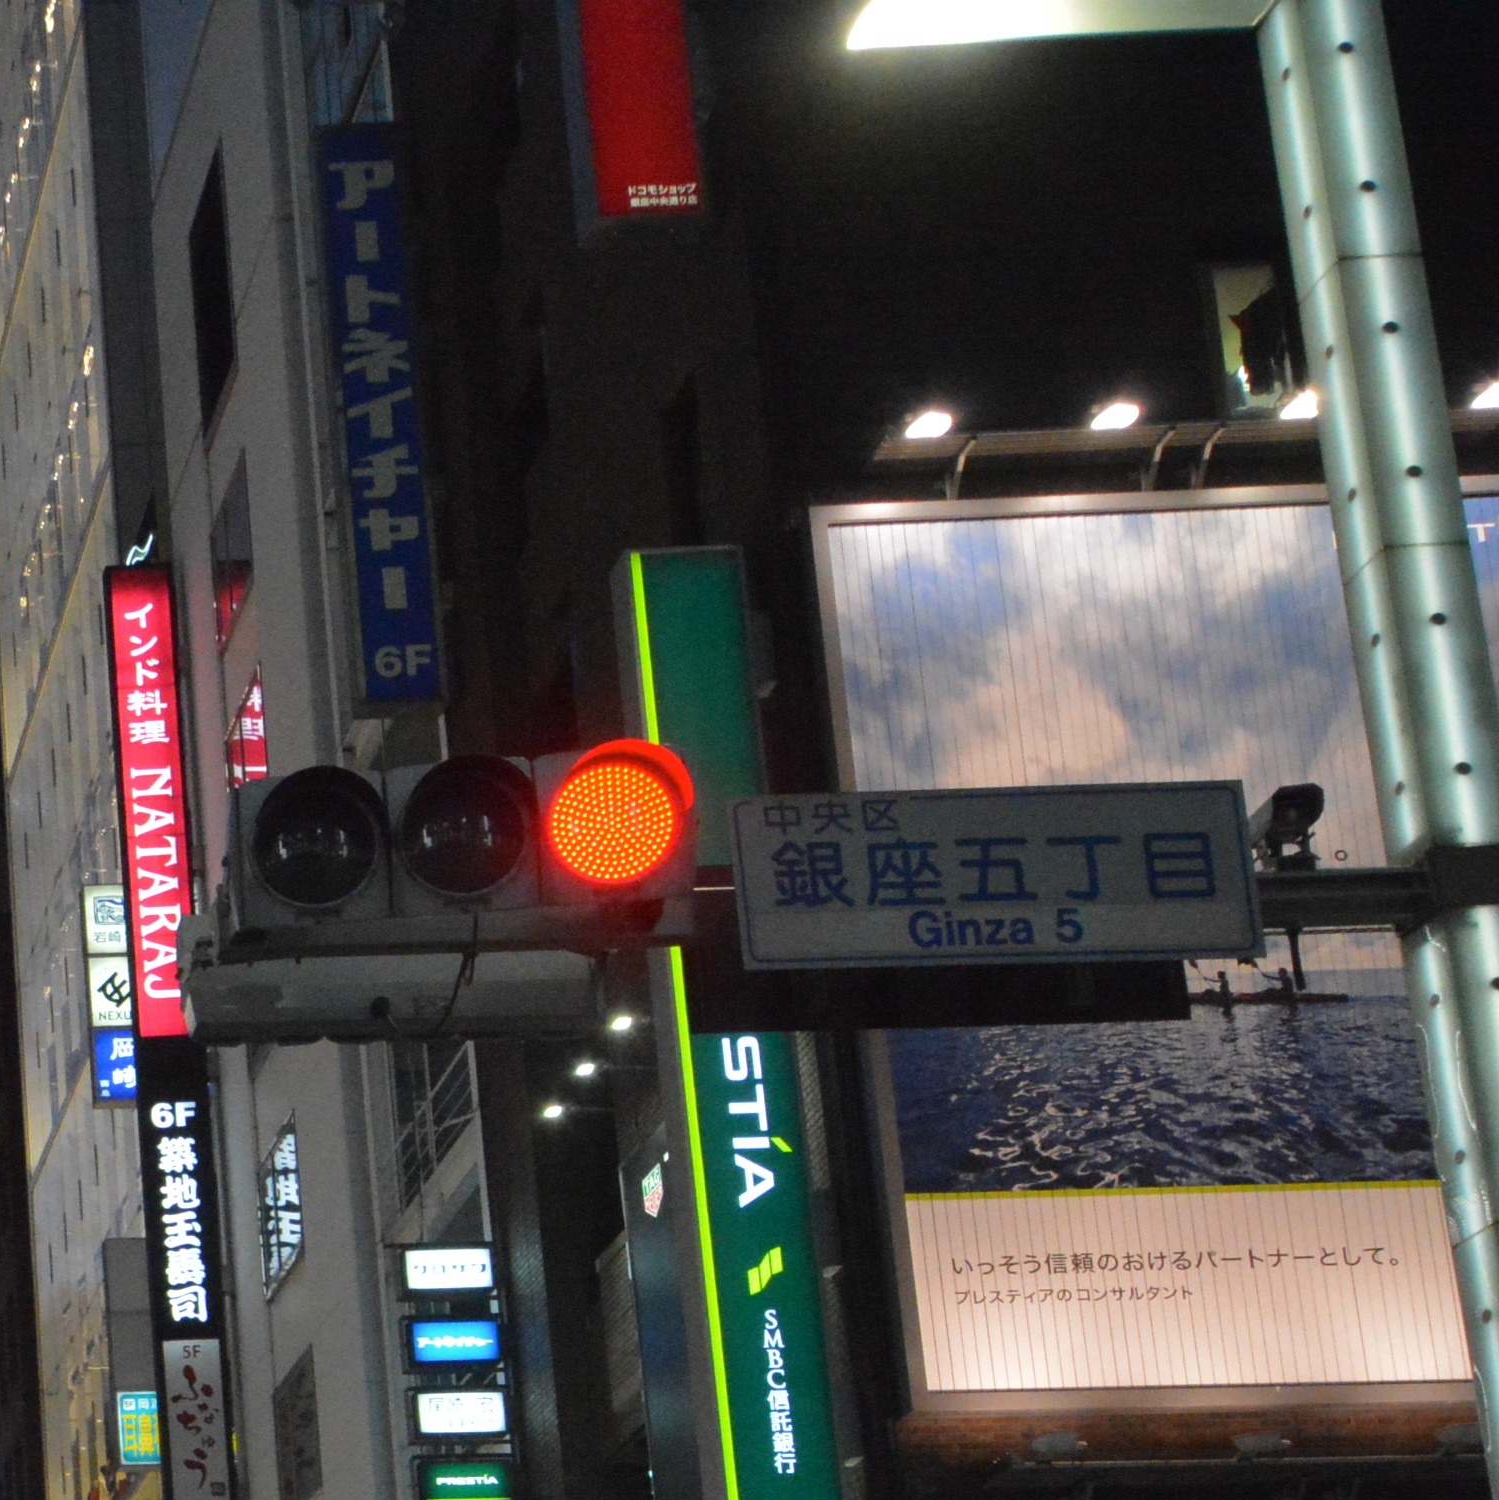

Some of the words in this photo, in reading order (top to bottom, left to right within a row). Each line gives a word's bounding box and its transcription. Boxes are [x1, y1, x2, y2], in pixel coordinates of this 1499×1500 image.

[328, 160, 420, 611] アートネイチャー
[123, 601, 170, 746] インド料理
[374, 643, 433, 679] 6F
[762, 799, 901, 834] 中央区
[129, 765, 183, 1000] NATARAJ
[770, 831, 1217, 909] 銀座五丁目
[908, 909, 1035, 948] Ginza
[1055, 907, 1085, 944] 5
[98, 1010, 133, 1021] NEXU
[150, 1101, 197, 1129] 6F
[721, 1035, 793, 1209] STÍA
[950, 1245, 1401, 1276] いっそう信頼のおけるパートナーとして。
[953, 1283, 1195, 1305] プレスティアのコンサルタント
[182, 1344, 202, 1359] 5F
[761, 1308, 795, 1475] SMBC信託銀行
